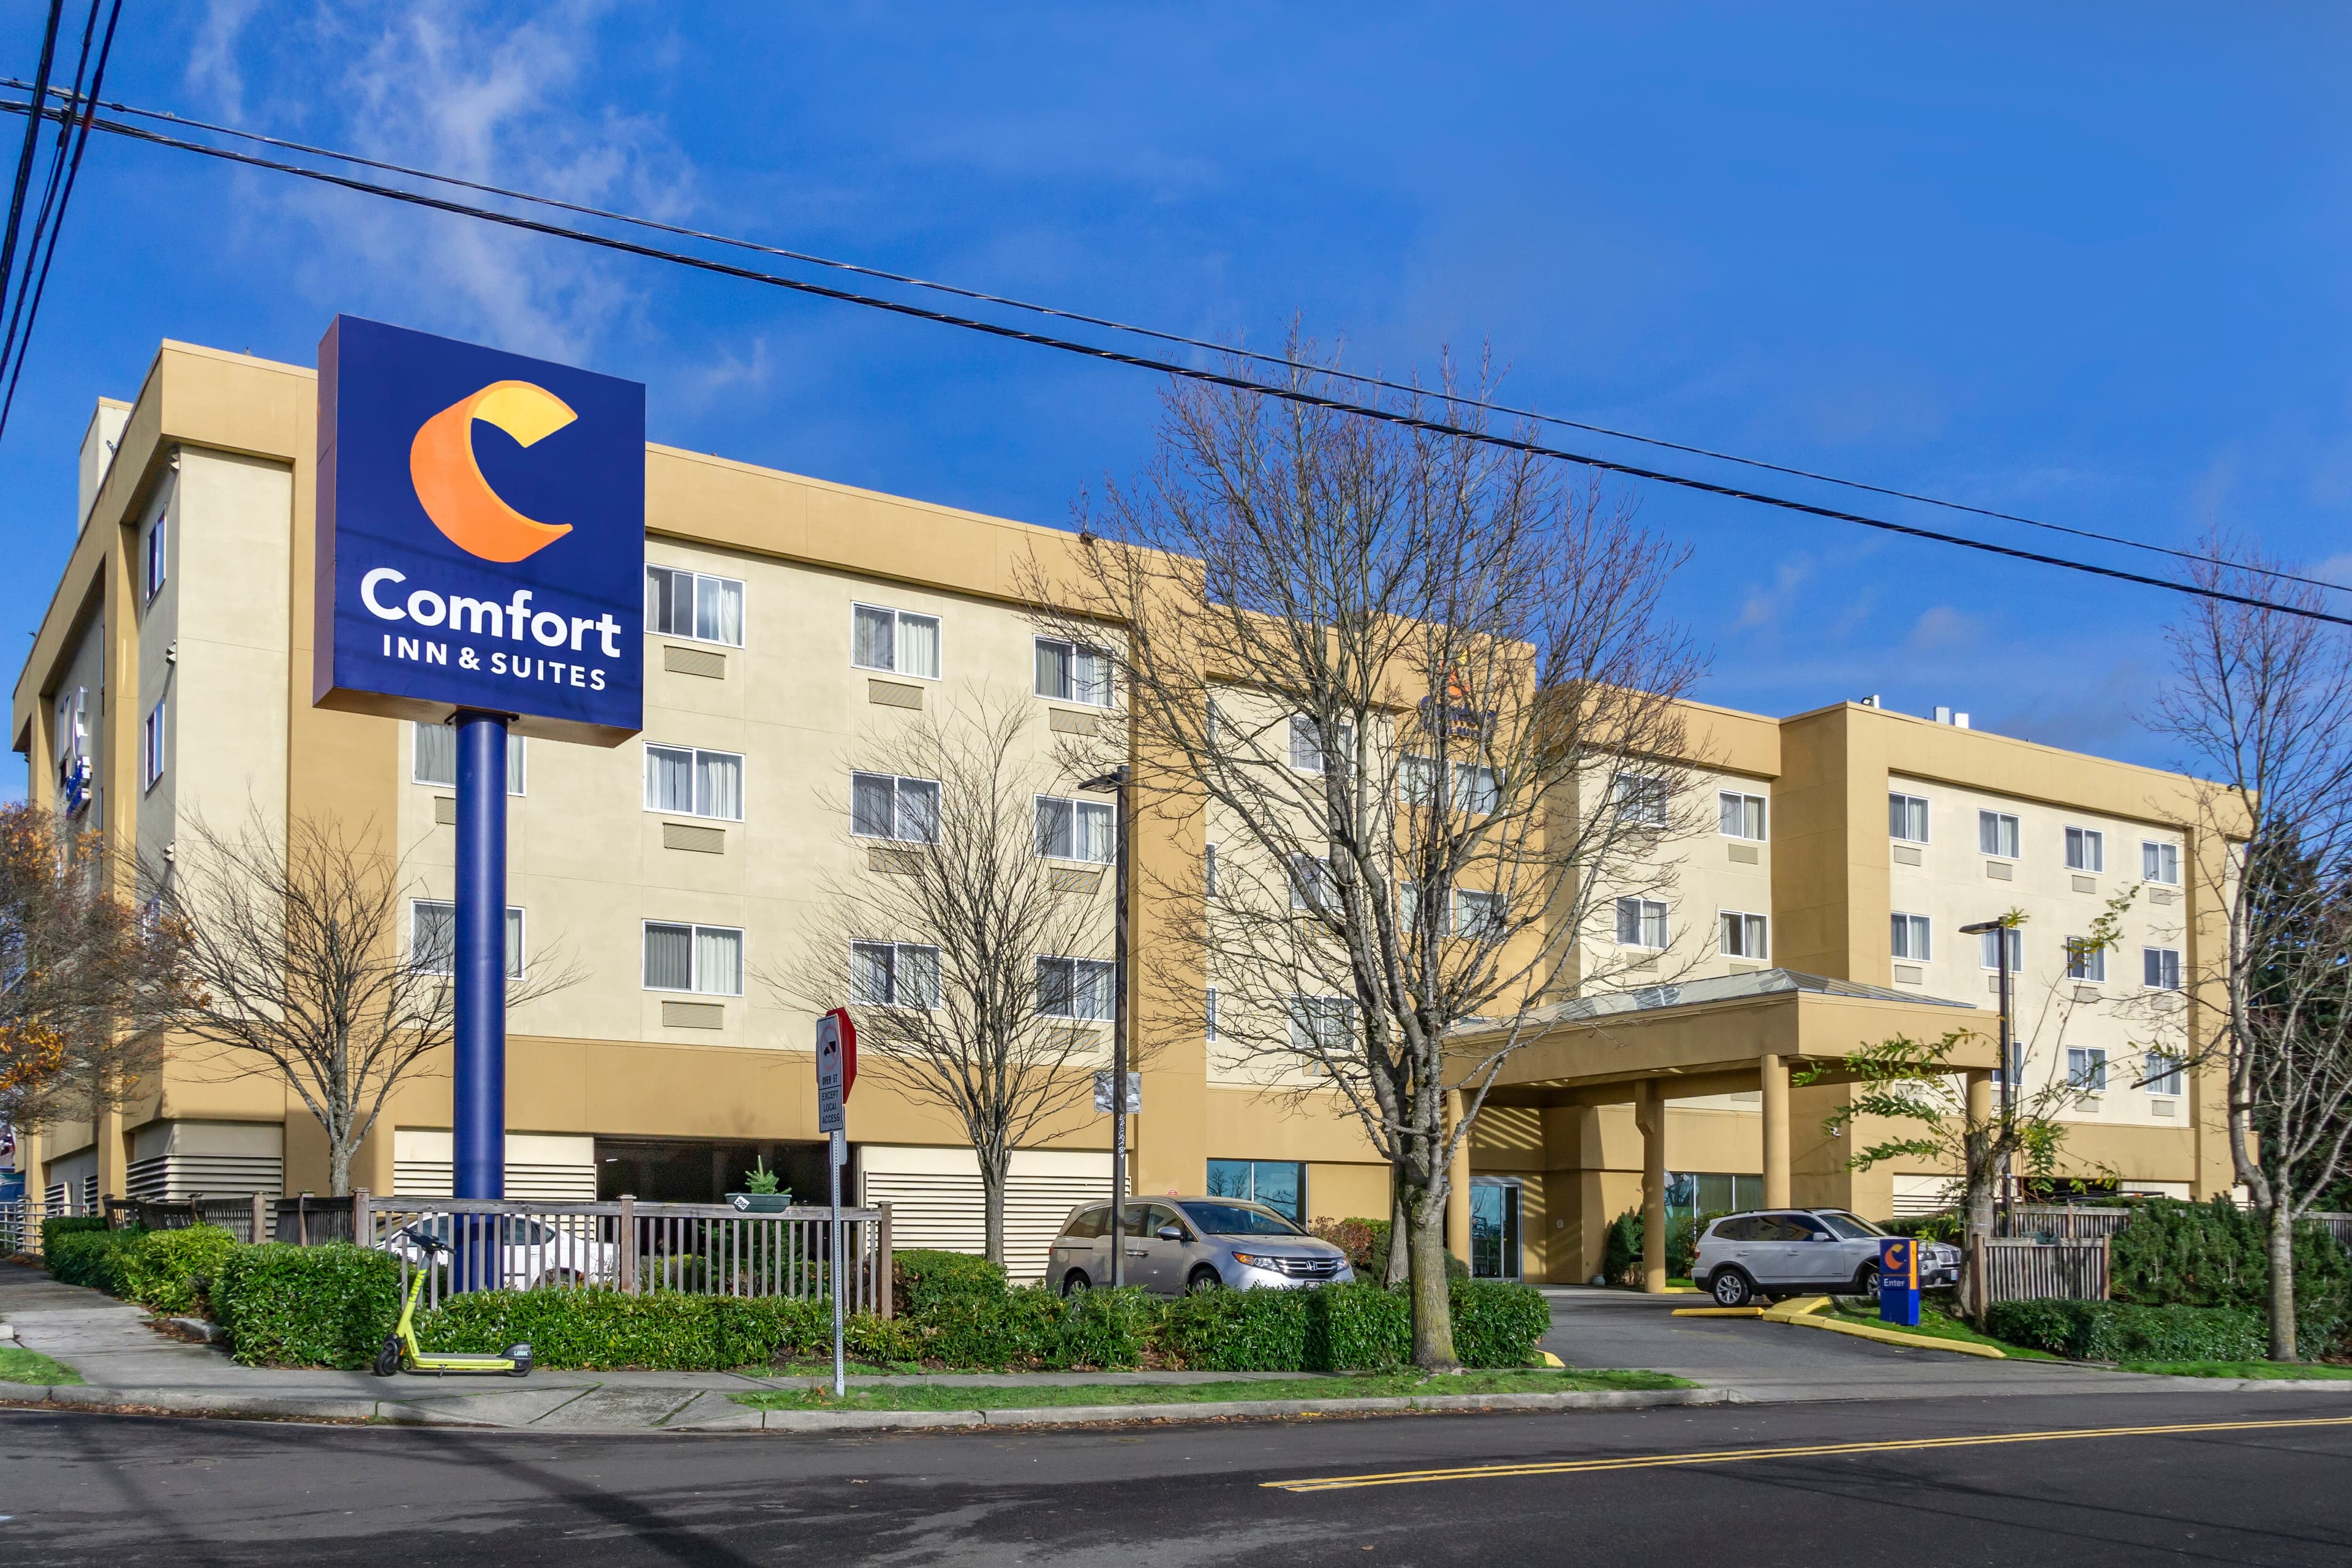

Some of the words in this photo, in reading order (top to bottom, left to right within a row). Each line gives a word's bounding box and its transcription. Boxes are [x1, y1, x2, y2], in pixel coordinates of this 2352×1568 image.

[361, 567, 621, 658] Comfort
[383, 634, 447, 665] INN
[458, 647, 481, 671] &
[491, 652, 605, 691] SUITES
[823, 1076, 831, 1085] OVER
[822, 1090, 838, 1101] EXCEPT
[824, 1102, 837, 1112] LOCAL
[822, 1113, 840, 1124] ACCESS
[736, 1199, 747, 1208] 216
